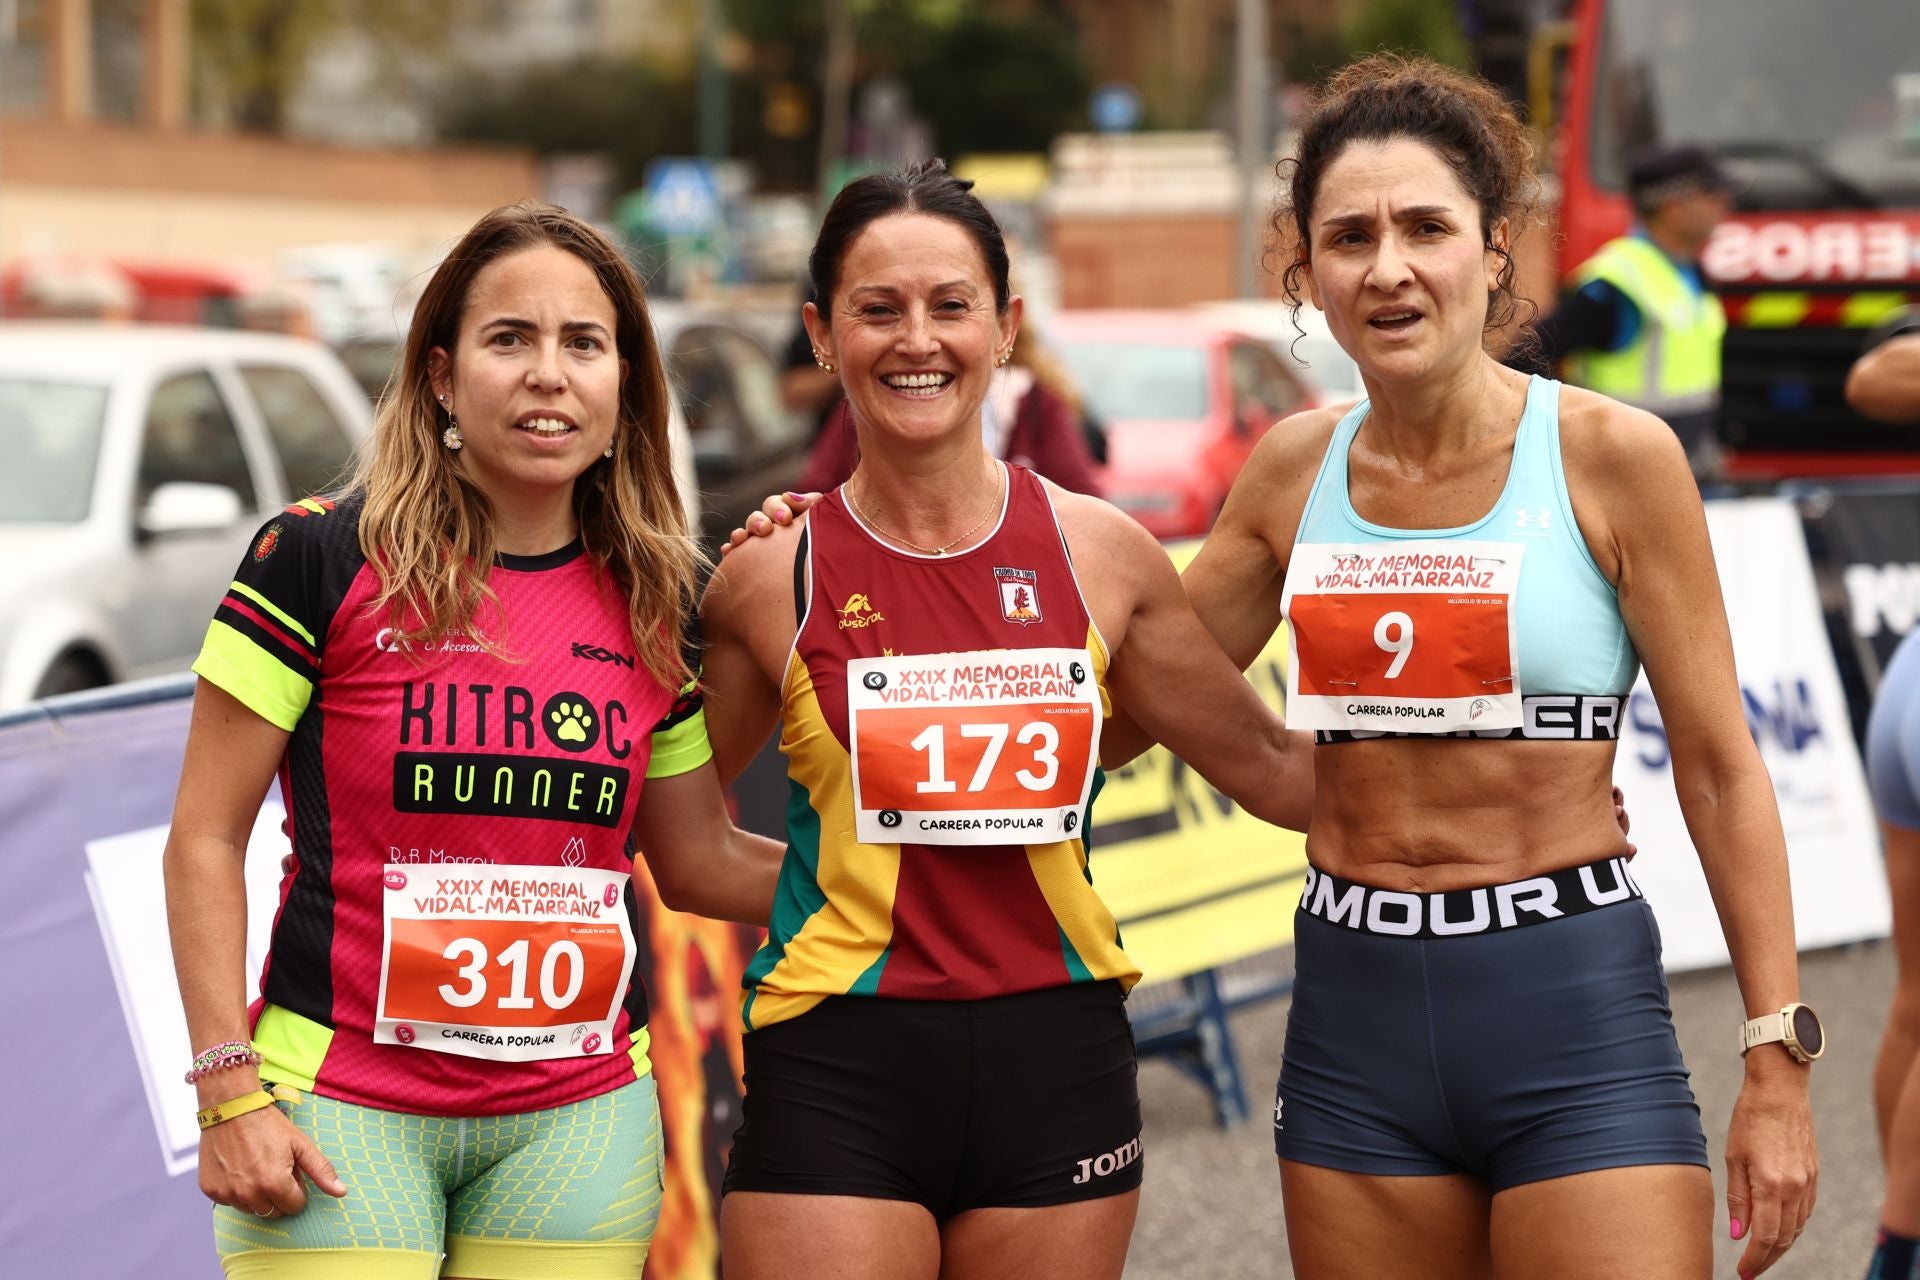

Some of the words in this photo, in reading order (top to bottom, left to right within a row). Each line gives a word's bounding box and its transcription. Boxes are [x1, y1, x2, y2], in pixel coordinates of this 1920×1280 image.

[1334, 555, 1374, 573] XXIX
[1378, 554, 1476, 573] MEMORIAL
[1314, 571, 1494, 589] VIDAL-MATARRANZ
[838, 611, 886, 630] austral
[439, 639, 495, 653] Accesor
[571, 642, 635, 671] KON
[1373, 611, 1414, 680] 9
[899, 668, 946, 686] XXIX
[953, 662, 1064, 682] MEMORIAL
[878, 680, 1077, 703] VIDAL-MATARRANZ
[399, 681, 632, 760] KITROC
[1347, 703, 1393, 717] CARRERA
[1394, 705, 1445, 718] POPULAR
[910, 721, 1060, 794] 173
[414, 763, 618, 816] RUNNER
[919, 819, 981, 831] CARRERA
[985, 817, 1044, 830] POPULAR
[390, 846, 420, 864] R&B
[435, 879, 484, 897] XXIX
[490, 879, 588, 901] MEMORIAL
[414, 896, 601, 919] VIDAL-MATARRANZ
[438, 937, 586, 1010] 310
[441, 1029, 504, 1046] CARRERA
[507, 1034, 556, 1047] POPULAR
